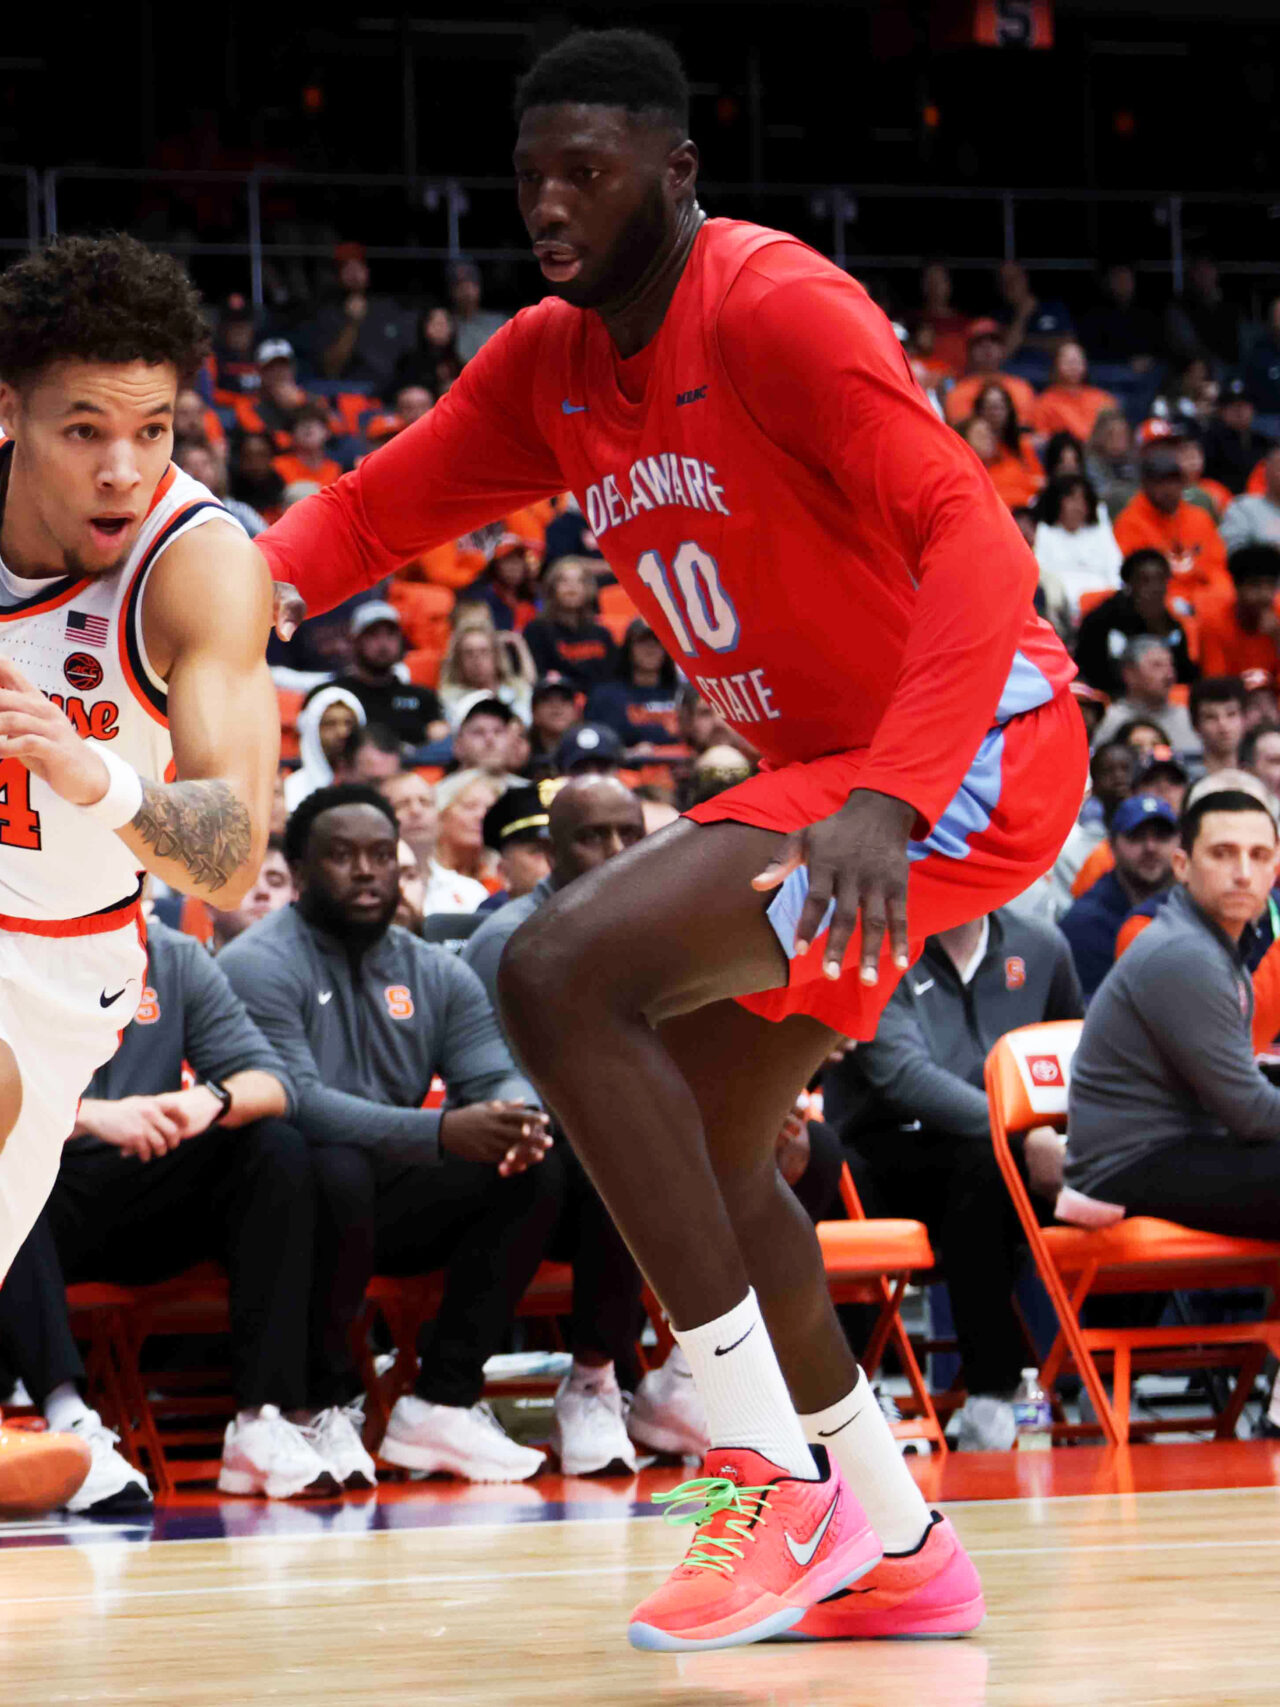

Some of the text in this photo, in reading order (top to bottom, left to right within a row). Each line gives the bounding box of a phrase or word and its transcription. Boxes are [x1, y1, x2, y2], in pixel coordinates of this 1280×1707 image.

[586, 453, 732, 538] DELAWARE
[636, 539, 742, 658] 10
[695, 668, 781, 722] STATE
[134, 986, 161, 1025] S
[384, 985, 415, 1020] S
